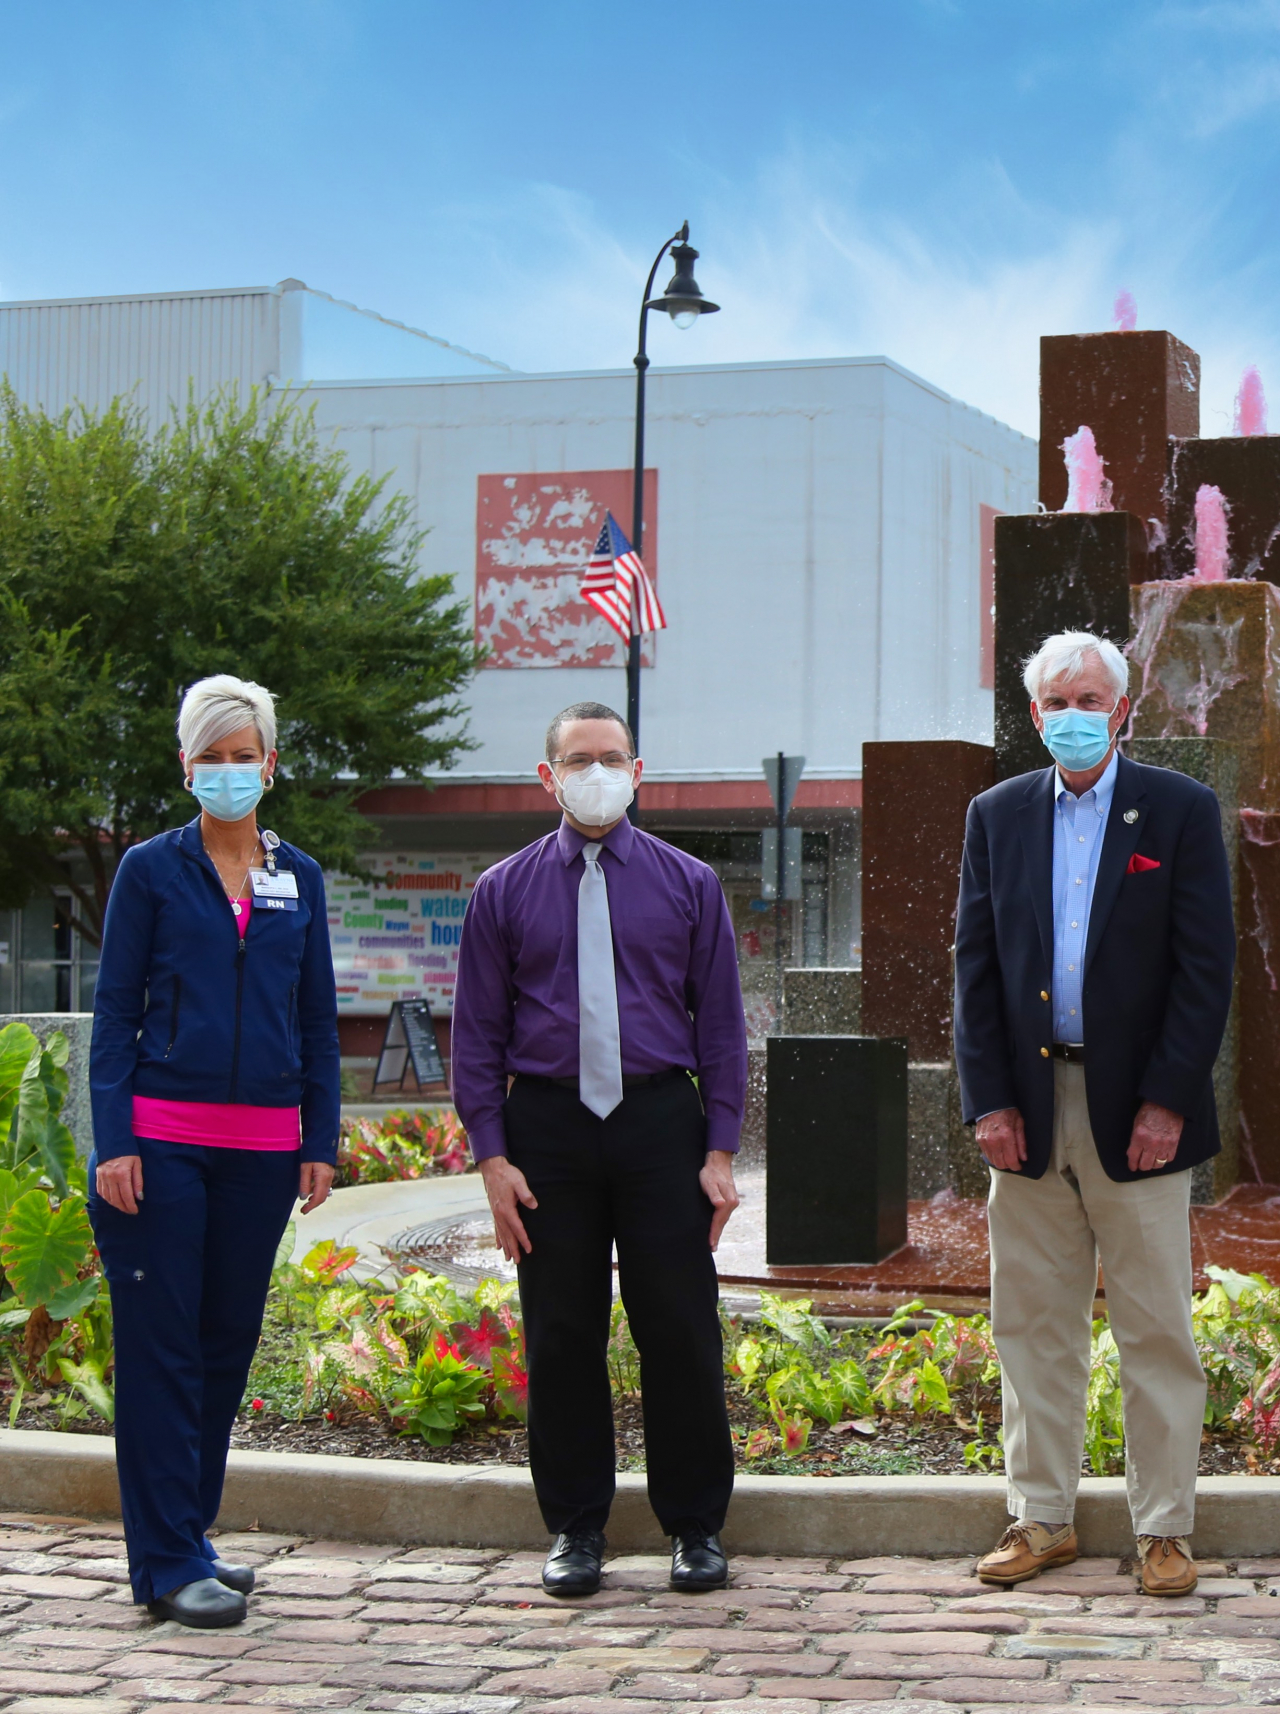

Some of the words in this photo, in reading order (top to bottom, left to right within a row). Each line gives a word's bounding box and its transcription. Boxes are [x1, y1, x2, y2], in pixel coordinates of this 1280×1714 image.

[386, 870, 462, 892] Community
[266, 899, 285, 909] RN
[421, 896, 469, 918] water
[343, 911, 384, 930] County
[359, 933, 425, 949] communities
[431, 920, 463, 946] hou
